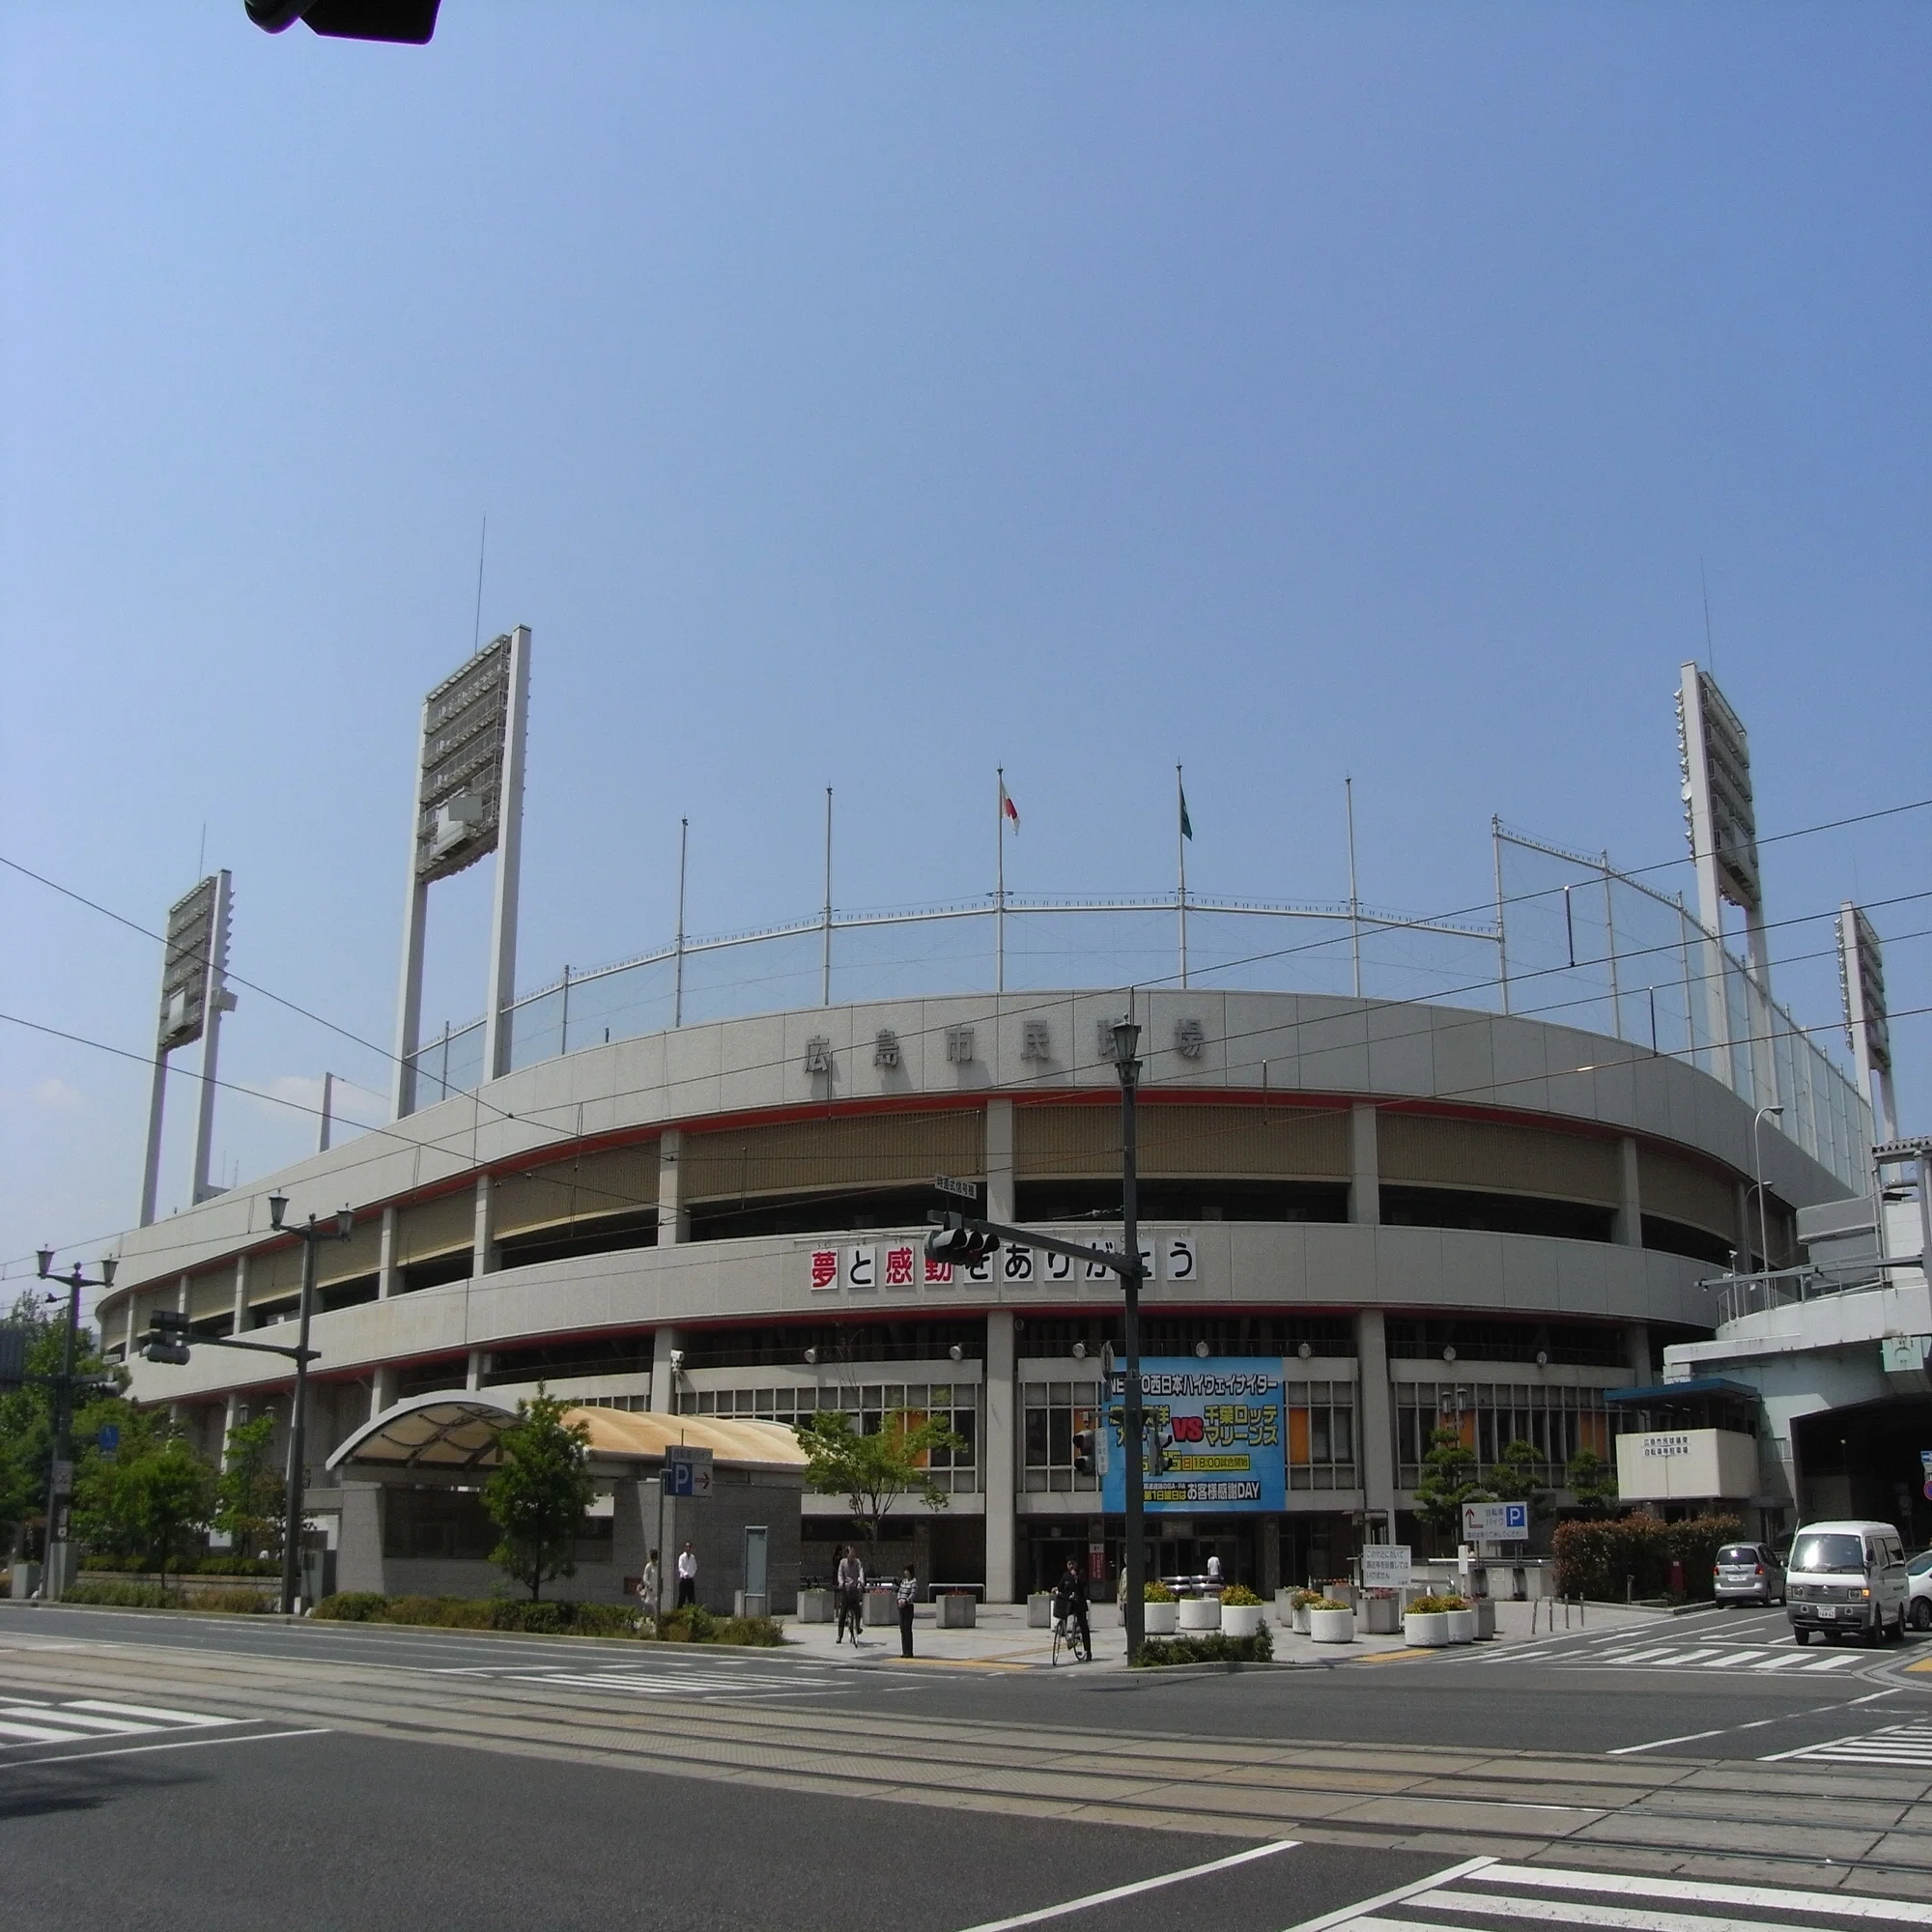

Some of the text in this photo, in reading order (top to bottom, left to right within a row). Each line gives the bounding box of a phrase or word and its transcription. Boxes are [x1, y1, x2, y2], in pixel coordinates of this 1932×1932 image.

[1111, 1375, 1278, 1396] NEO西日本ハイウェイナイター
[1204, 1405, 1278, 1424] 千葉ロッテ
[1172, 1417, 1203, 1442] VS
[676, 1463, 689, 1492] P
[1187, 1482, 1260, 1500] お客様感謝DAY
[1510, 1508, 1520, 1525] P
